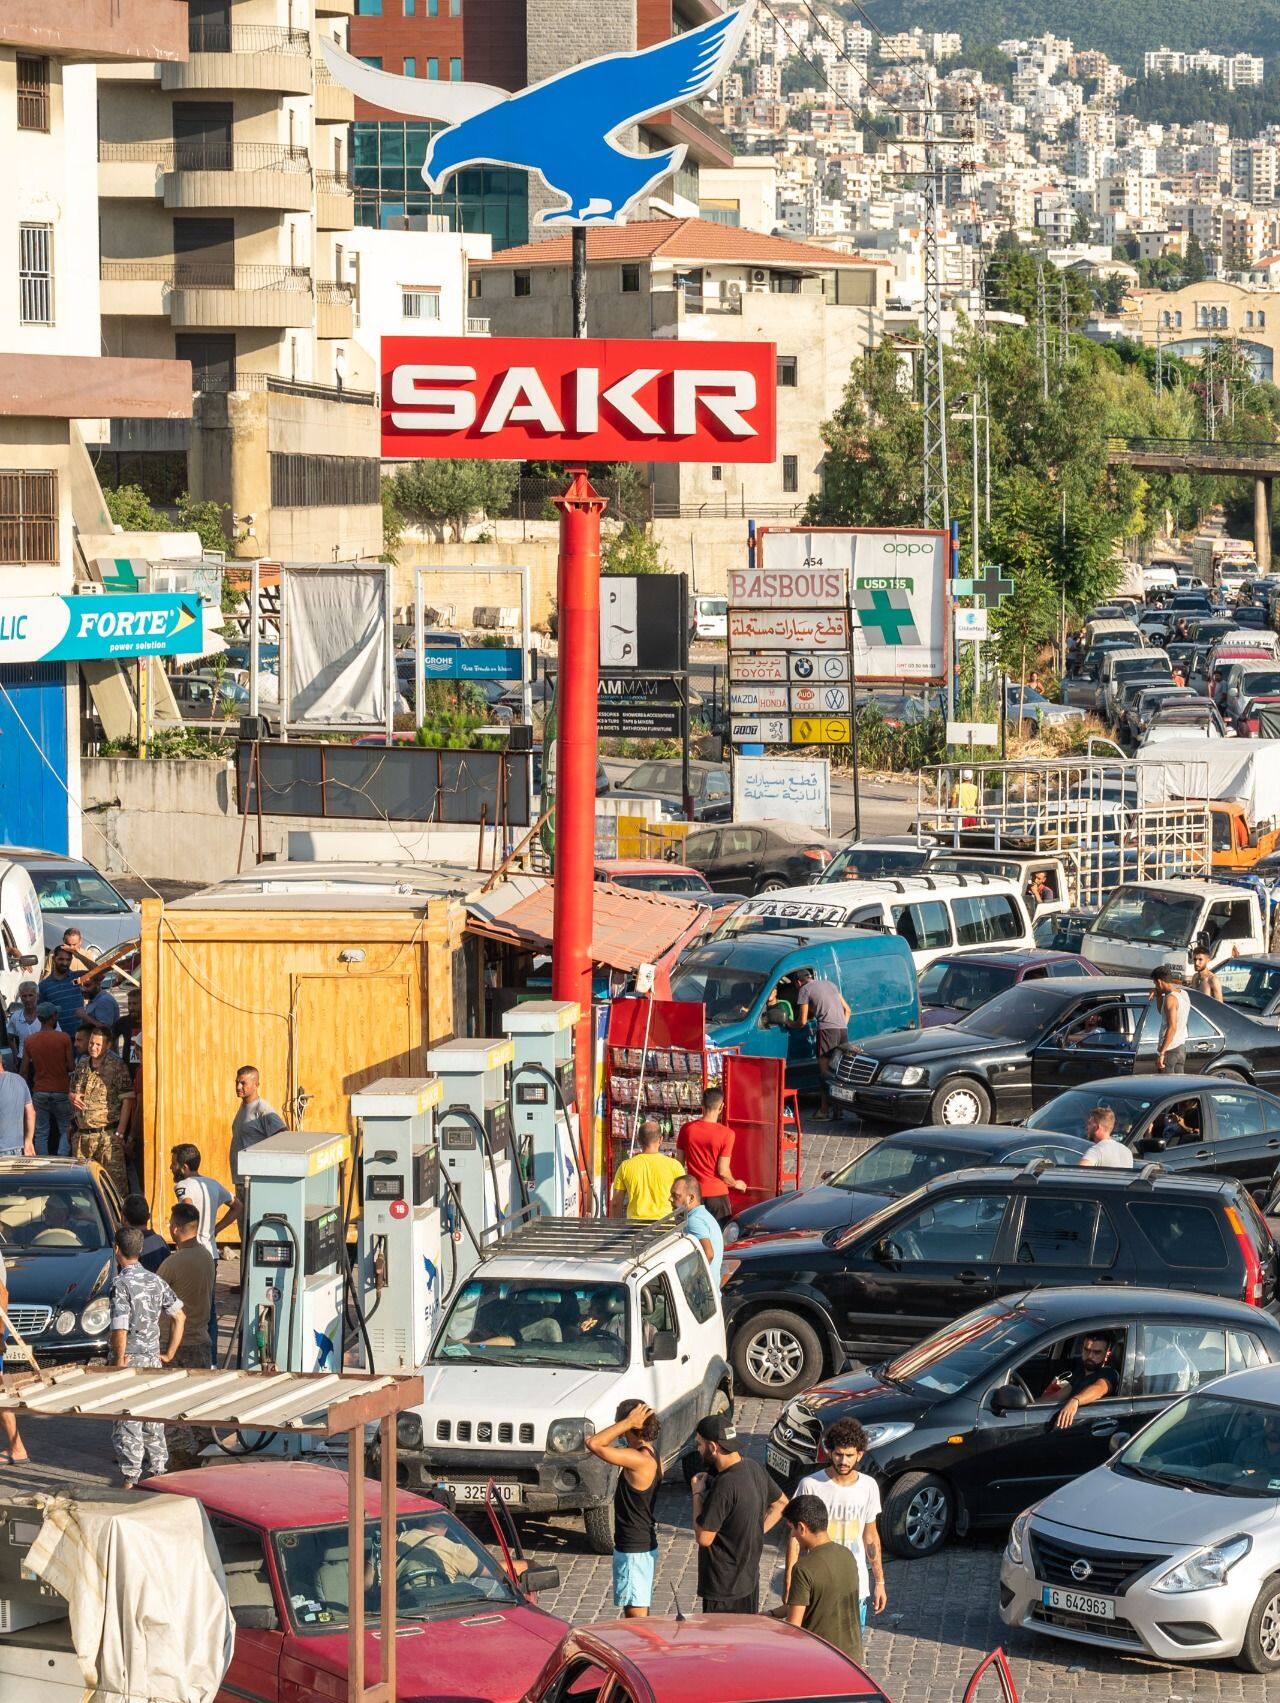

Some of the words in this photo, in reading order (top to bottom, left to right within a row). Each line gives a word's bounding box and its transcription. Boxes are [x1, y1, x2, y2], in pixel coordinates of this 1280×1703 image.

[391, 364, 759, 437] SAKR
[883, 543, 934, 557] oppo
[802, 557, 823, 567] A54
[731, 574, 840, 598] BASBOUS
[863, 579, 888, 588] USD
[76, 610, 168, 638] FORTE
[814, 616, 844, 648] قطع
[109, 643, 134, 652] power
[135, 641, 166, 650] solution
[425, 656, 453, 664] GROHE
[735, 668, 781, 678] TOYOTA
[597, 680, 658, 695] AMMAM
[731, 695, 758, 704] MAZDA
[760, 699, 787, 708] HONDA
[733, 725, 758, 735] FIAT
[788, 773, 818, 792] قطع
[454, 1232, 461, 1242] 9
[1052, 1591, 1059, 1605] G
[1065, 1594, 1107, 1615] 642963
